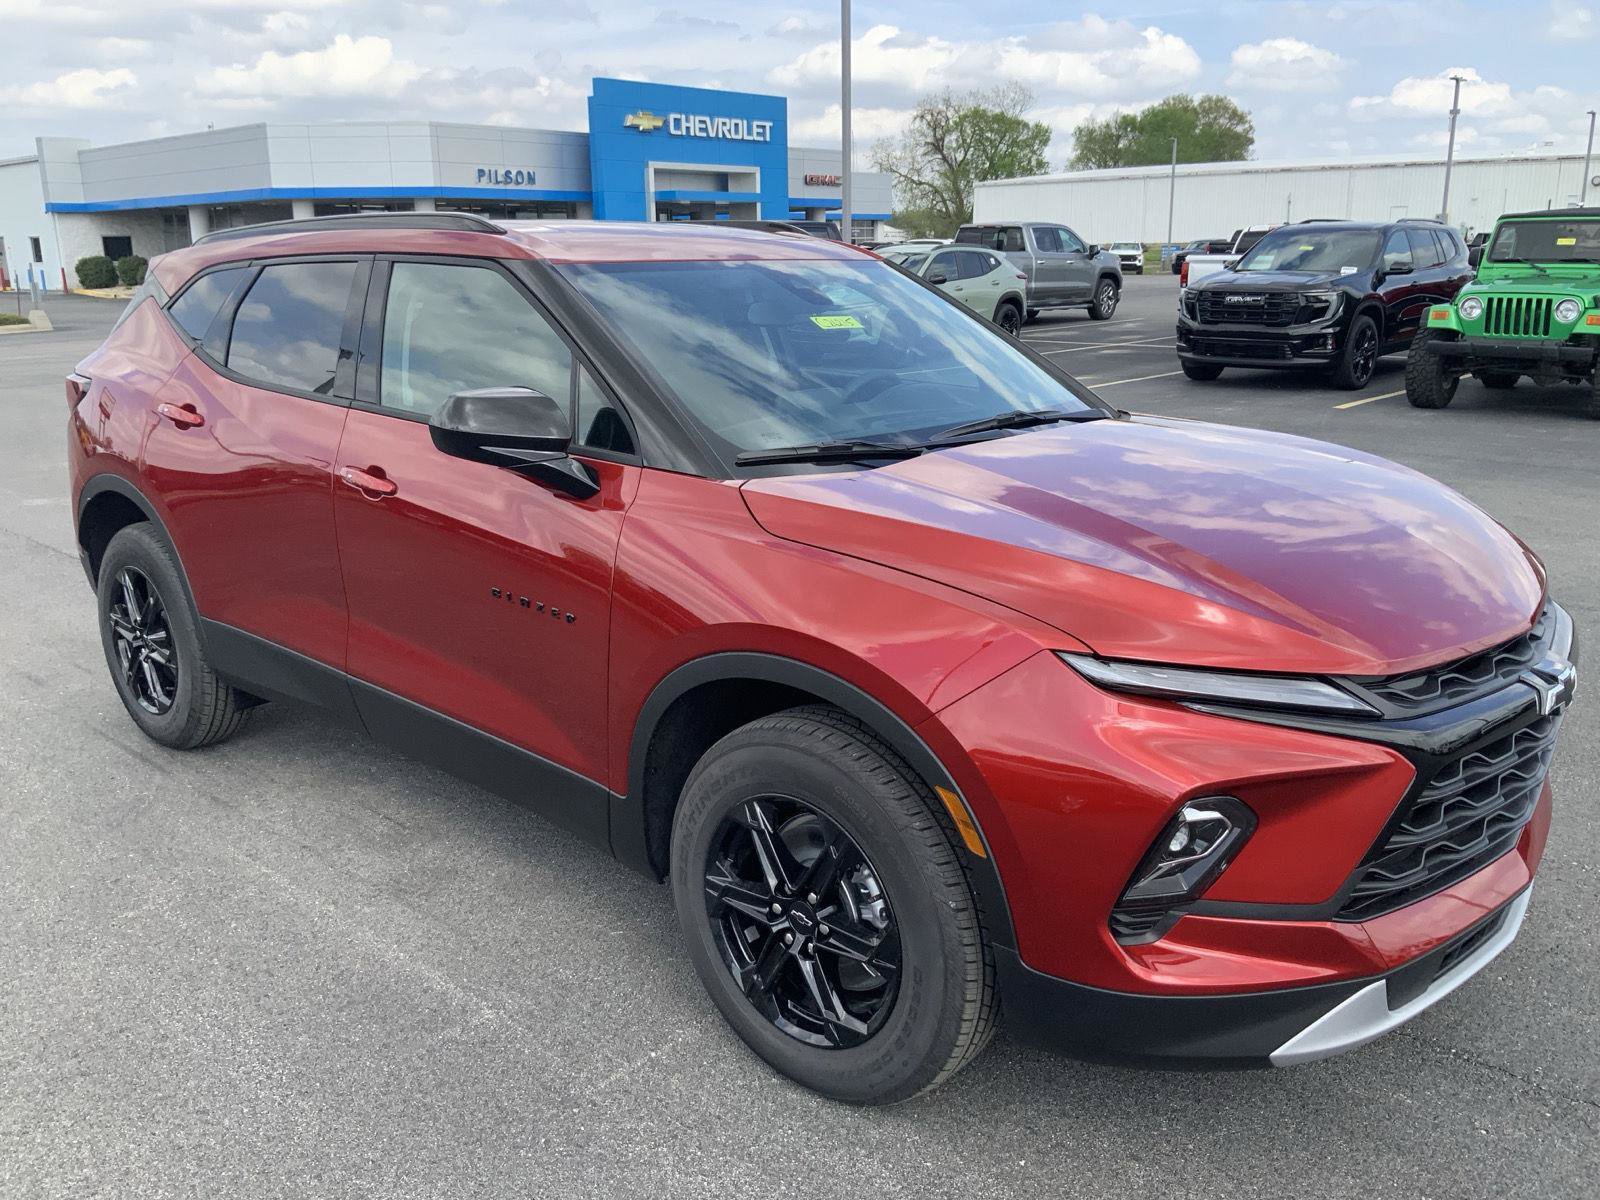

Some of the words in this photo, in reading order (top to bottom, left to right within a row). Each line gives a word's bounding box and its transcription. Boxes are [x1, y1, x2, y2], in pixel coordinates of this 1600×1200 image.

[669, 112, 773, 143] CHEVROLET
[477, 168, 537, 186] PILSON
[1224, 295, 1266, 305] GMC
